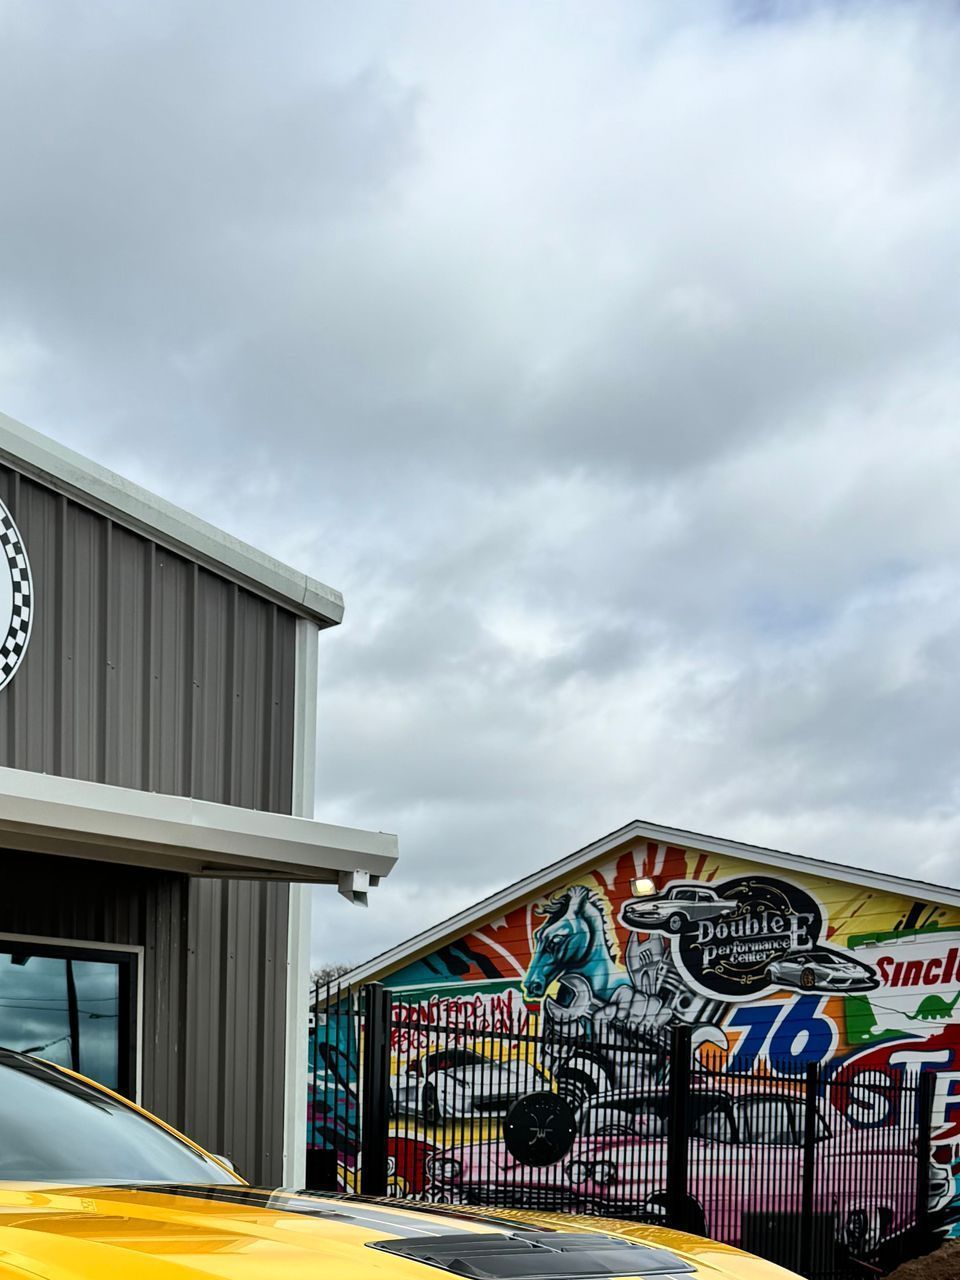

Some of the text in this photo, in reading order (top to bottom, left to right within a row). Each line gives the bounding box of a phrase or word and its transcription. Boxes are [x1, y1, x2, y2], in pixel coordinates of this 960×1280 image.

[696, 910, 816, 952] Double E
[875, 947, 960, 988] Sincl
[725, 994, 834, 1076] 76
